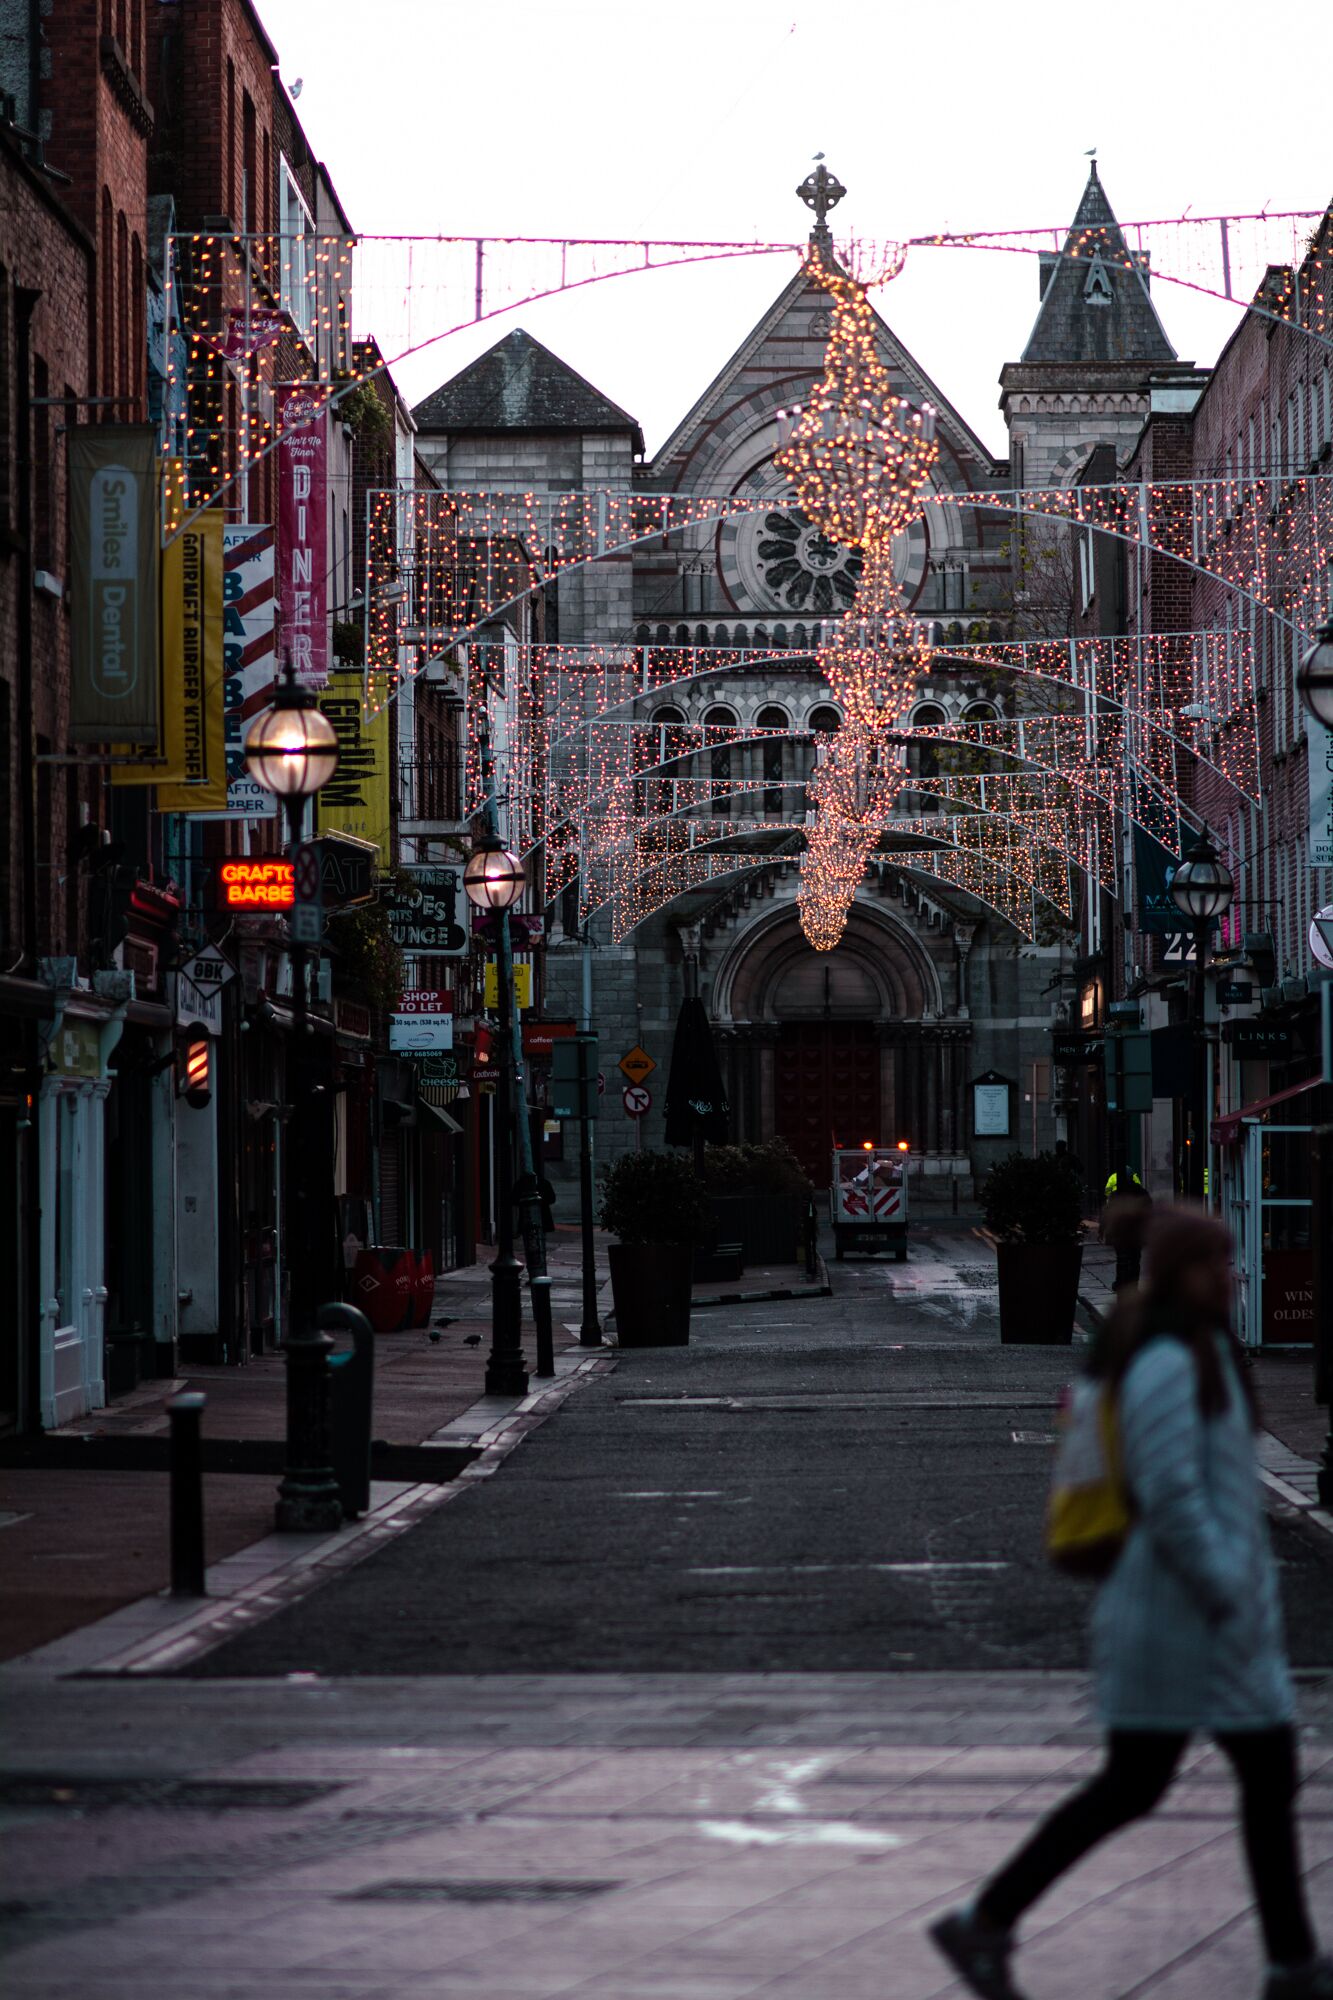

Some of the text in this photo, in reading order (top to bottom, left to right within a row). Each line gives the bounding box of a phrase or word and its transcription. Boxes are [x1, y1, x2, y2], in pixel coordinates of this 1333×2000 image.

[307, 437, 322, 446] No
[290, 447, 316, 457] Finer
[292, 464, 313, 669] DINER
[102, 479, 128, 678] Smiles Dental
[183, 533, 201, 785] GOURMET BURGER KITCHEN
[223, 571, 247, 779] BARBER
[320, 698, 382, 807] GOTHAM
[227, 885, 295, 902] BARBE
[393, 925, 449, 945] UNGE
[1163, 932, 1198, 961] 22
[194, 962, 225, 980] GBK
[403, 992, 439, 1001] SHOP
[398, 1002, 443, 1012] TO LET
[1239, 1031, 1288, 1041] LINKS
